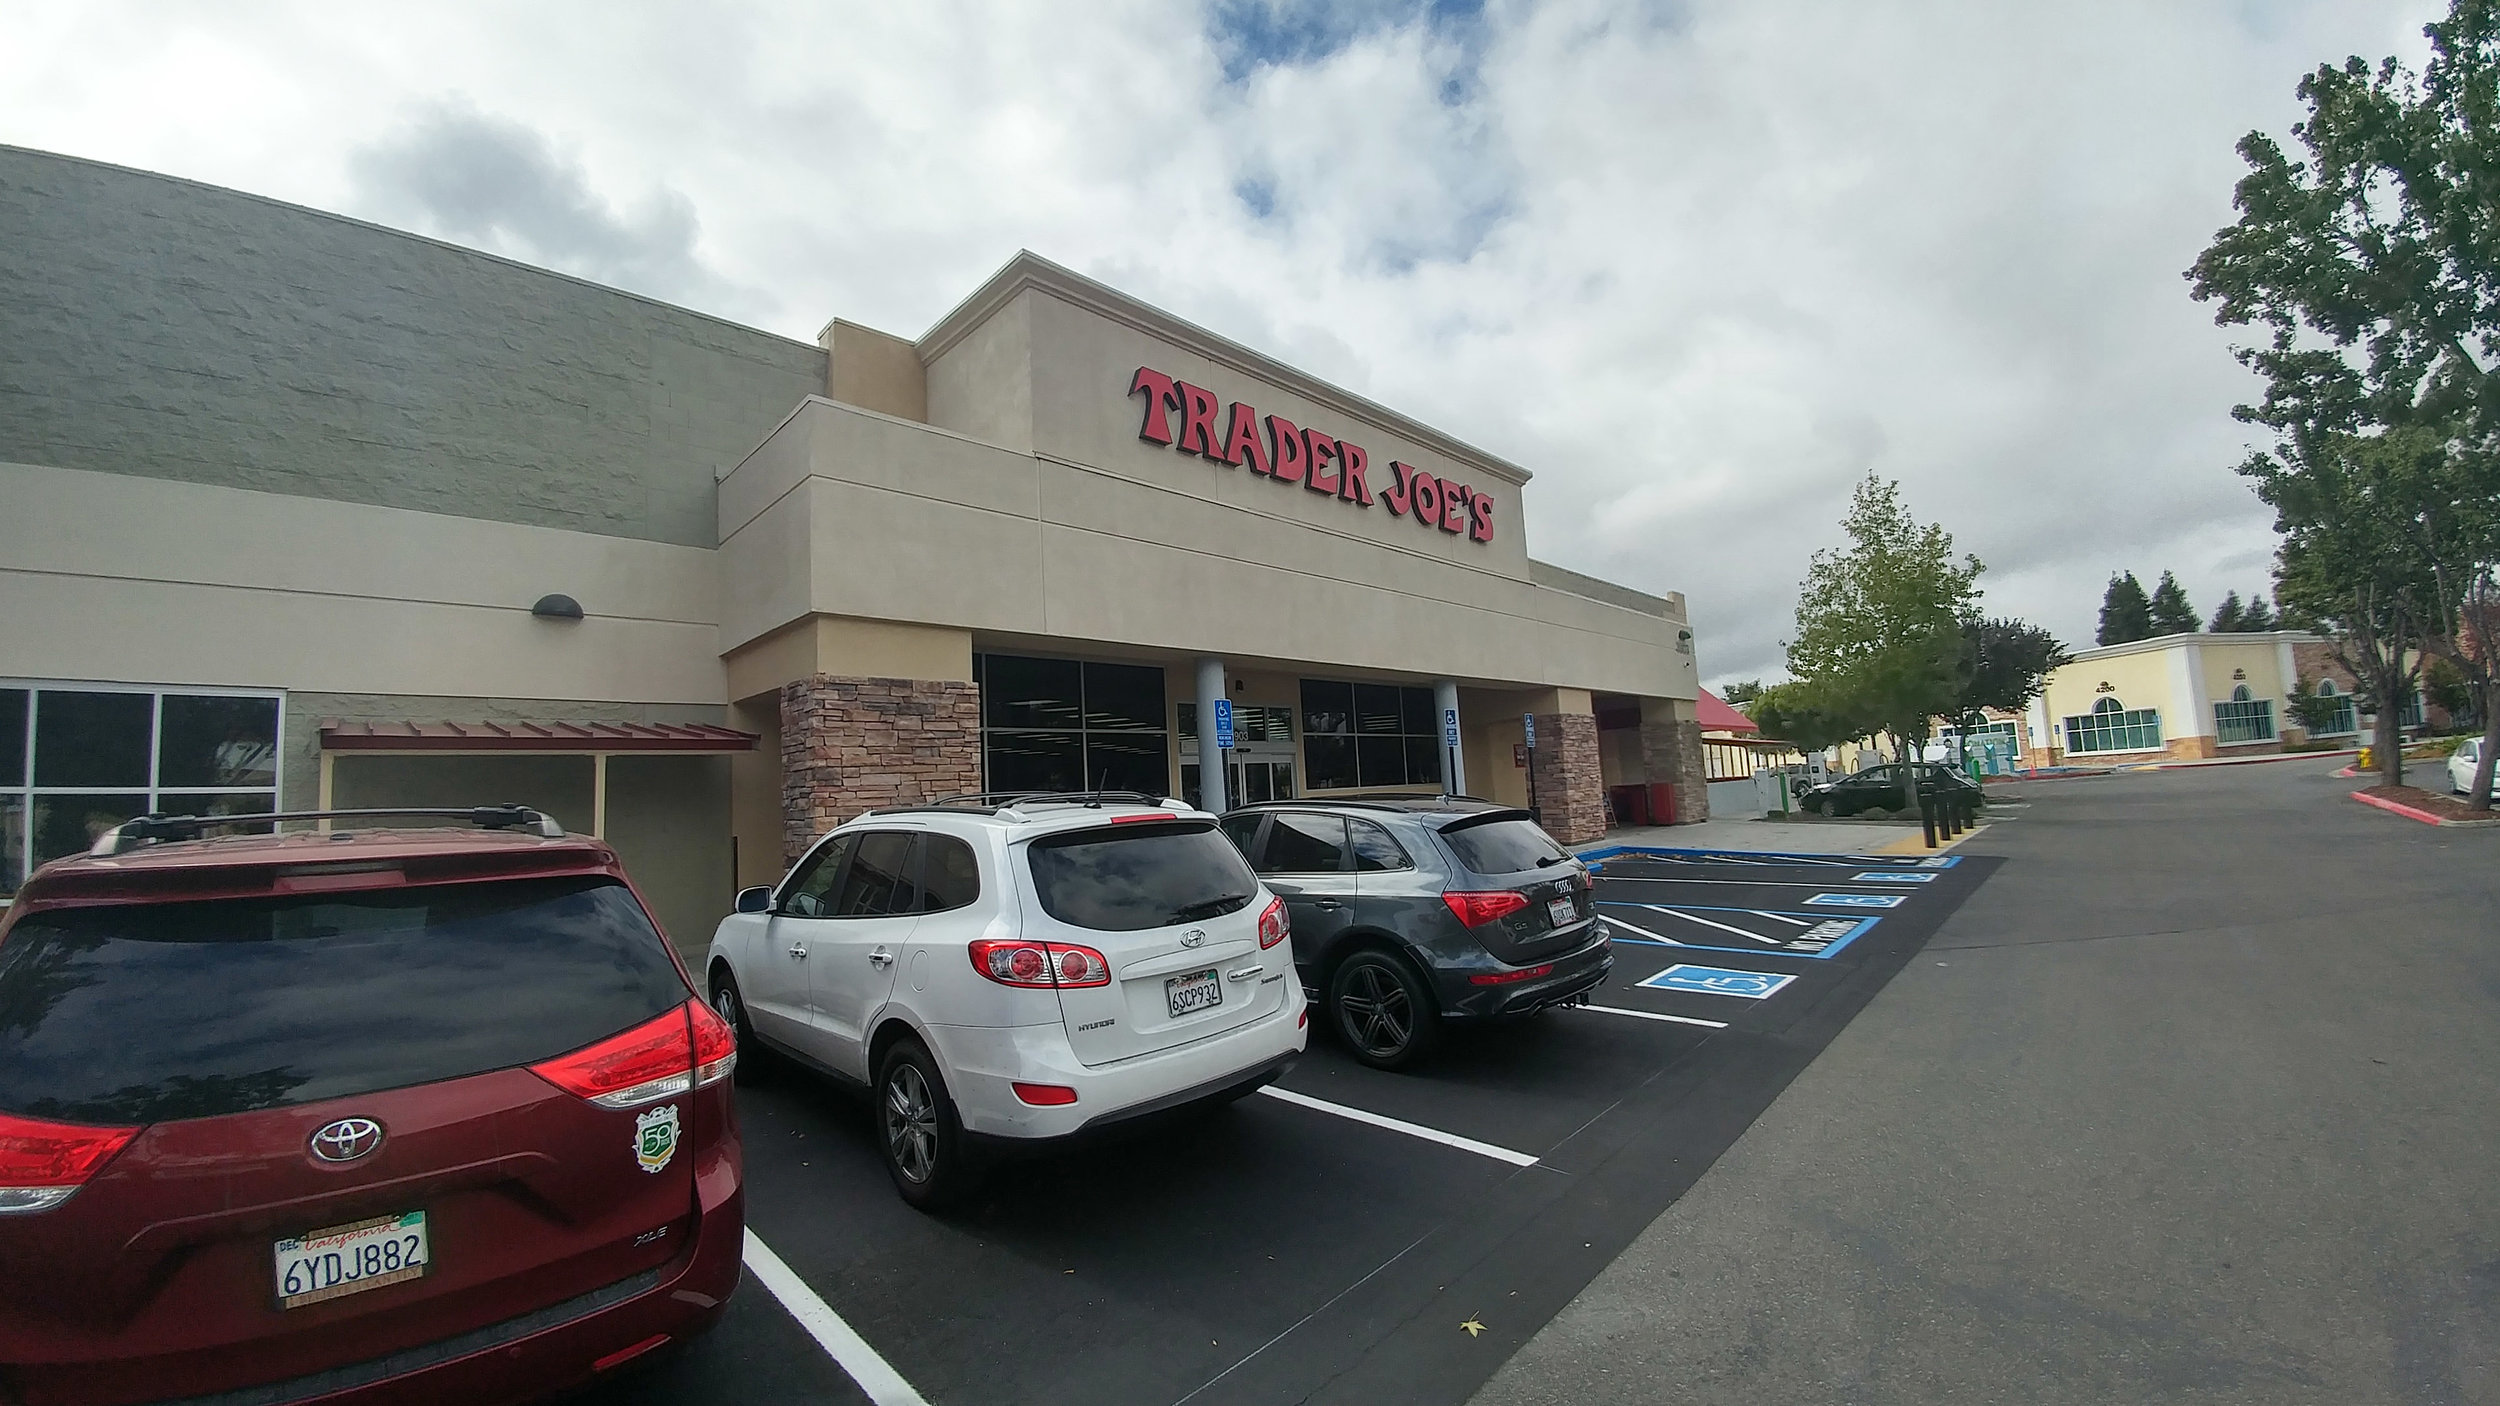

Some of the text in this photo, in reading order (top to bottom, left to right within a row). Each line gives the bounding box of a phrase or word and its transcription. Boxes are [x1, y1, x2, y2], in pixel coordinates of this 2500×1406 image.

[1128, 366, 1494, 544] TRADER JOE'S
[2095, 685, 2115, 693] 4200
[1172, 983, 1218, 1011] 6SCP932
[1078, 1019, 1115, 1031] HYUNDAI
[280, 1239, 299, 1252] DEC
[305, 1223, 401, 1250] California
[634, 1226, 668, 1247] XLE
[284, 1234, 421, 1295] 6YDJ882
